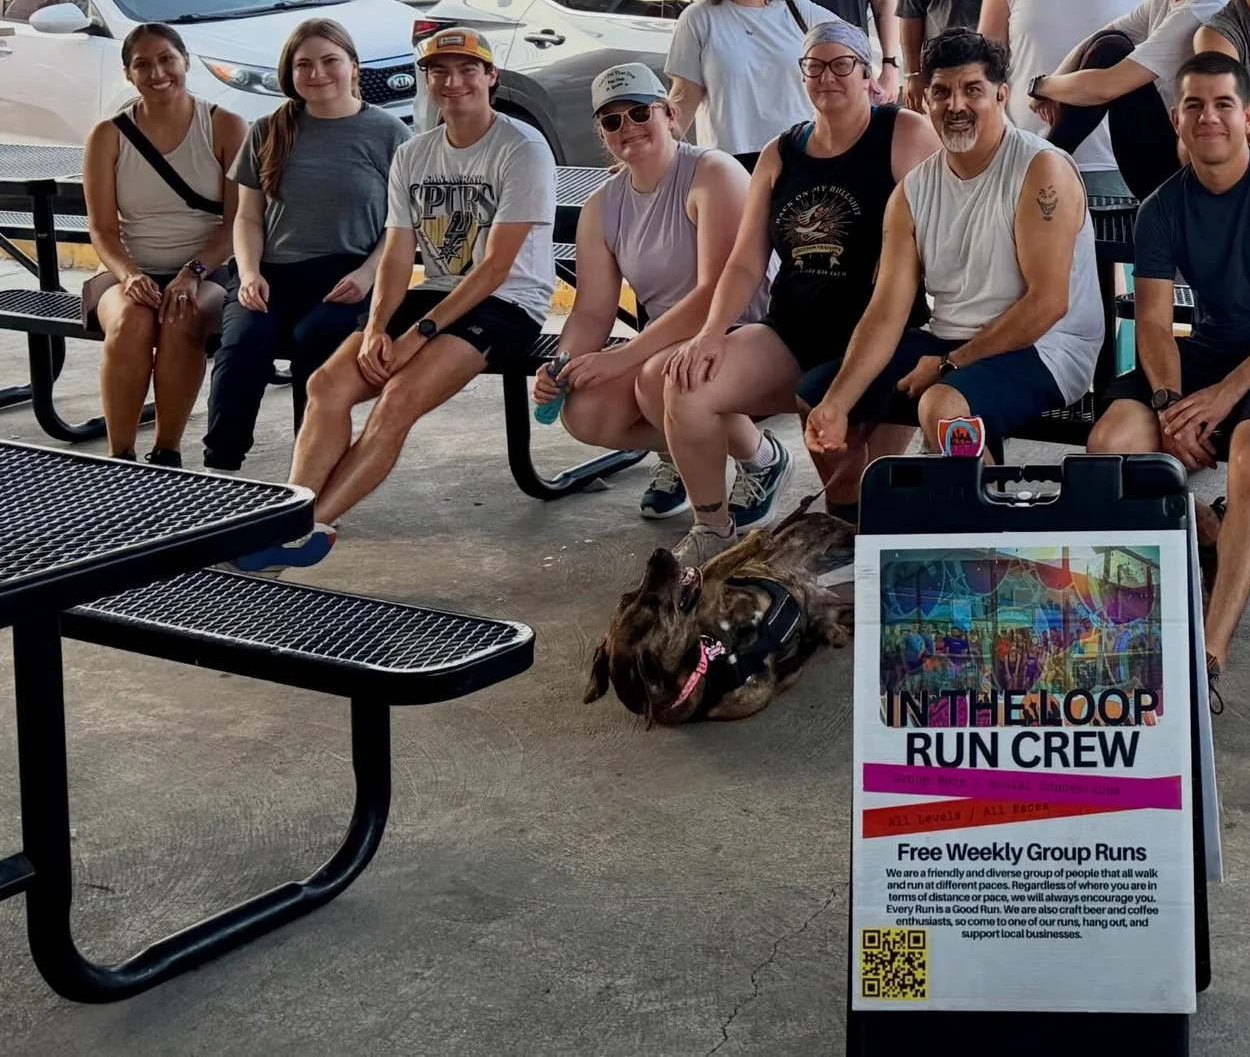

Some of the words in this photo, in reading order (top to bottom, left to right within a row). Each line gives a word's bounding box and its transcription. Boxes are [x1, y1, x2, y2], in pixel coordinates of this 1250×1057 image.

[394, 78, 413, 87] KIA
[410, 183, 497, 228] SPURS
[830, 186, 861, 216] BULLSHIT
[886, 690, 928, 726] IN
[941, 690, 1027, 726] THE
[1040, 689, 1159, 727] LOOP
[906, 732, 998, 768] RUN
[1011, 731, 1140, 768] CREW
[894, 774, 930, 786] Group
[988, 778, 1031, 790] Social
[888, 814, 910, 827] All
[918, 810, 961, 824] Levels
[983, 804, 1004, 816] All
[1012, 802, 1049, 814] Paces
[898, 843, 942, 861] Free
[946, 842, 1023, 866] Weekly
[1027, 843, 1091, 866] Group
[1095, 843, 1147, 861] Runs
[886, 869, 902, 878] We
[927, 868, 965, 879] friendly
[966, 868, 984, 878] and
[986, 868, 1021, 878] diverse
[1023, 871, 1052, 880] group
[1054, 868, 1064, 878] of
[1065, 869, 1100, 879] people
[1101, 869, 1120, 878] that
[1121, 869, 1133, 878] all
[1134, 869, 1158, 878] walk
[887, 881, 906, 890] and
[936, 880, 977, 890] different
[979, 882, 1010, 891] paces.
[1012, 881, 1066, 892] Regardless
[1067, 880, 1077, 890] of
[1078, 881, 1109, 890] where
[1110, 883, 1129, 892] you
[1148, 881, 1157, 890] in
[888, 893, 916, 902] terms
[918, 892, 928, 902] of
[928, 892, 970, 902] distance
[983, 895, 1009, 903] pace,
[1027, 893, 1044, 902] will
[1045, 893, 1079, 904] always
[1080, 895, 1133, 904] encourage
[1135, 895, 1156, 904] you.
[886, 905, 914, 915] Every
[915, 905, 935, 914] Run
[936, 905, 943, 914] is
[952, 905, 979, 914] Good
[980, 905, 1002, 914] Run.
[1003, 905, 1020, 914] We
[1038, 905, 1058, 914] also
[1060, 905, 1082, 914] craft
[1083, 905, 1106, 914] beer
[1107, 905, 1126, 914] and
[1127, 905, 1159, 914] coffee
[896, 916, 953, 927] enthusiasts,
[997, 918, 1006, 926] to
[1028, 917, 1038, 926] of
[1057, 919, 1081, 928] runs,
[1082, 917, 1108, 929] hang
[1109, 918, 1128, 928] out,
[1129, 918, 1149, 927] and
[961, 930, 1000, 940] support
[1001, 929, 1024, 938] local
[1026, 929, 1082, 939] businesses.
